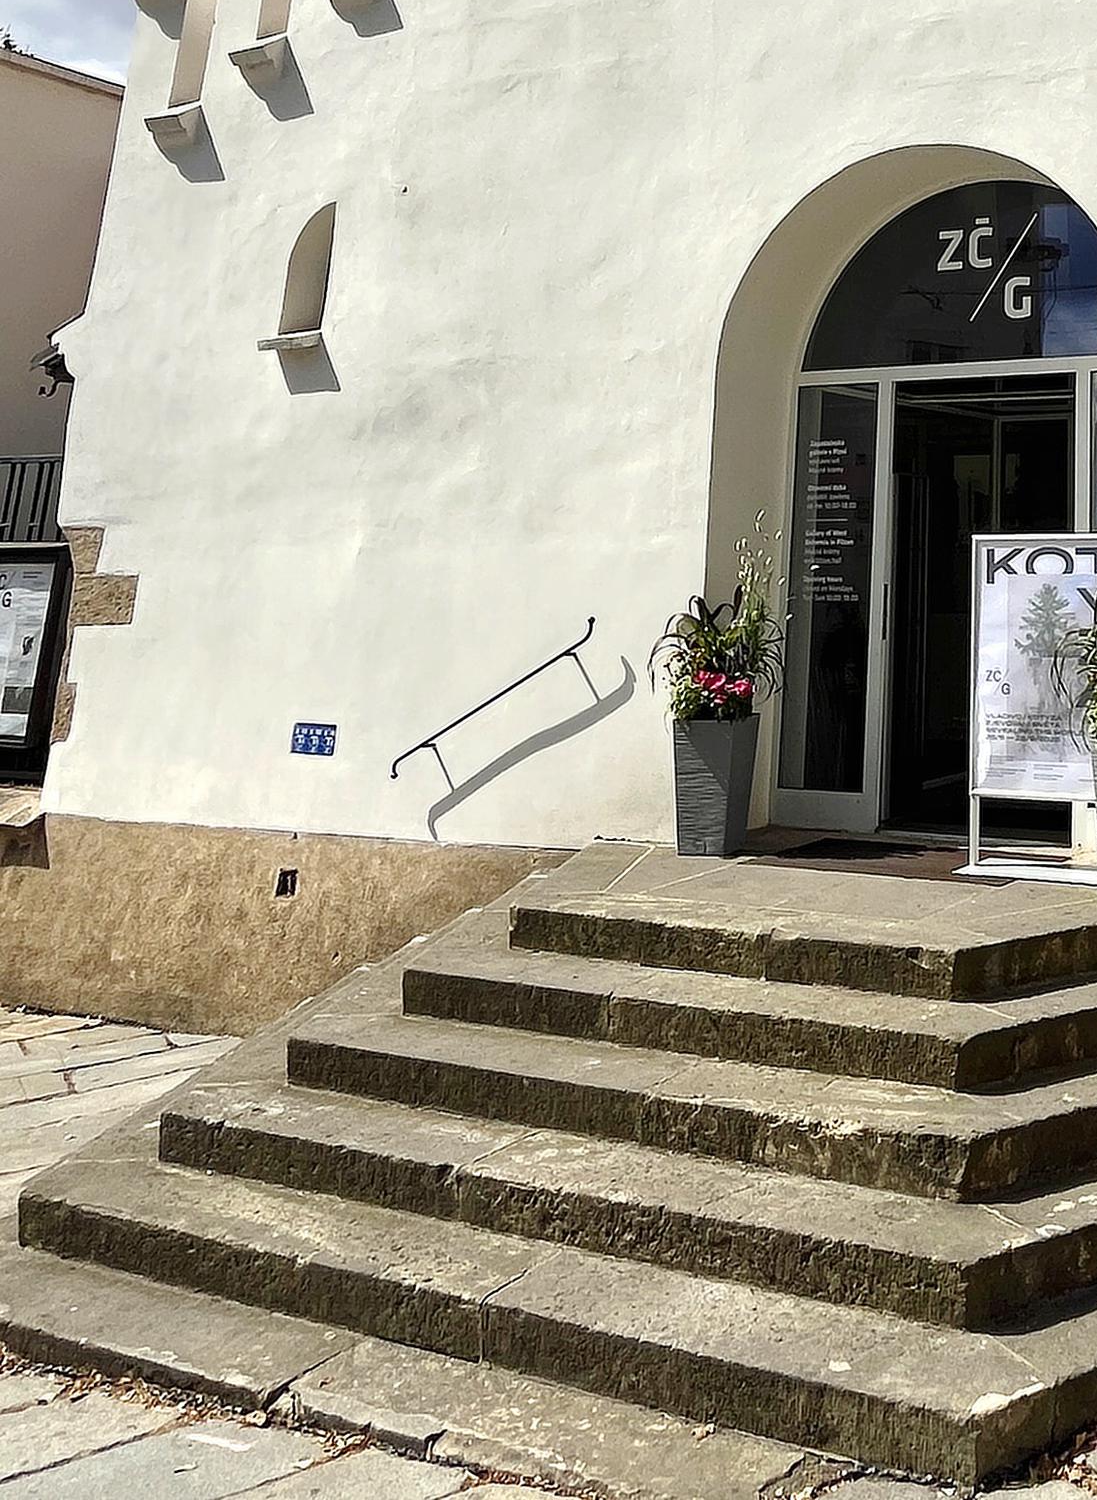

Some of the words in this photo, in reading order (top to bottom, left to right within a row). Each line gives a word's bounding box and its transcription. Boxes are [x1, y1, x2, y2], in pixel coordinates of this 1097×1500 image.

[1004, 276, 1031, 319] G
[2, 591, 12, 608] G
[1001, 683, 1011, 695] G
